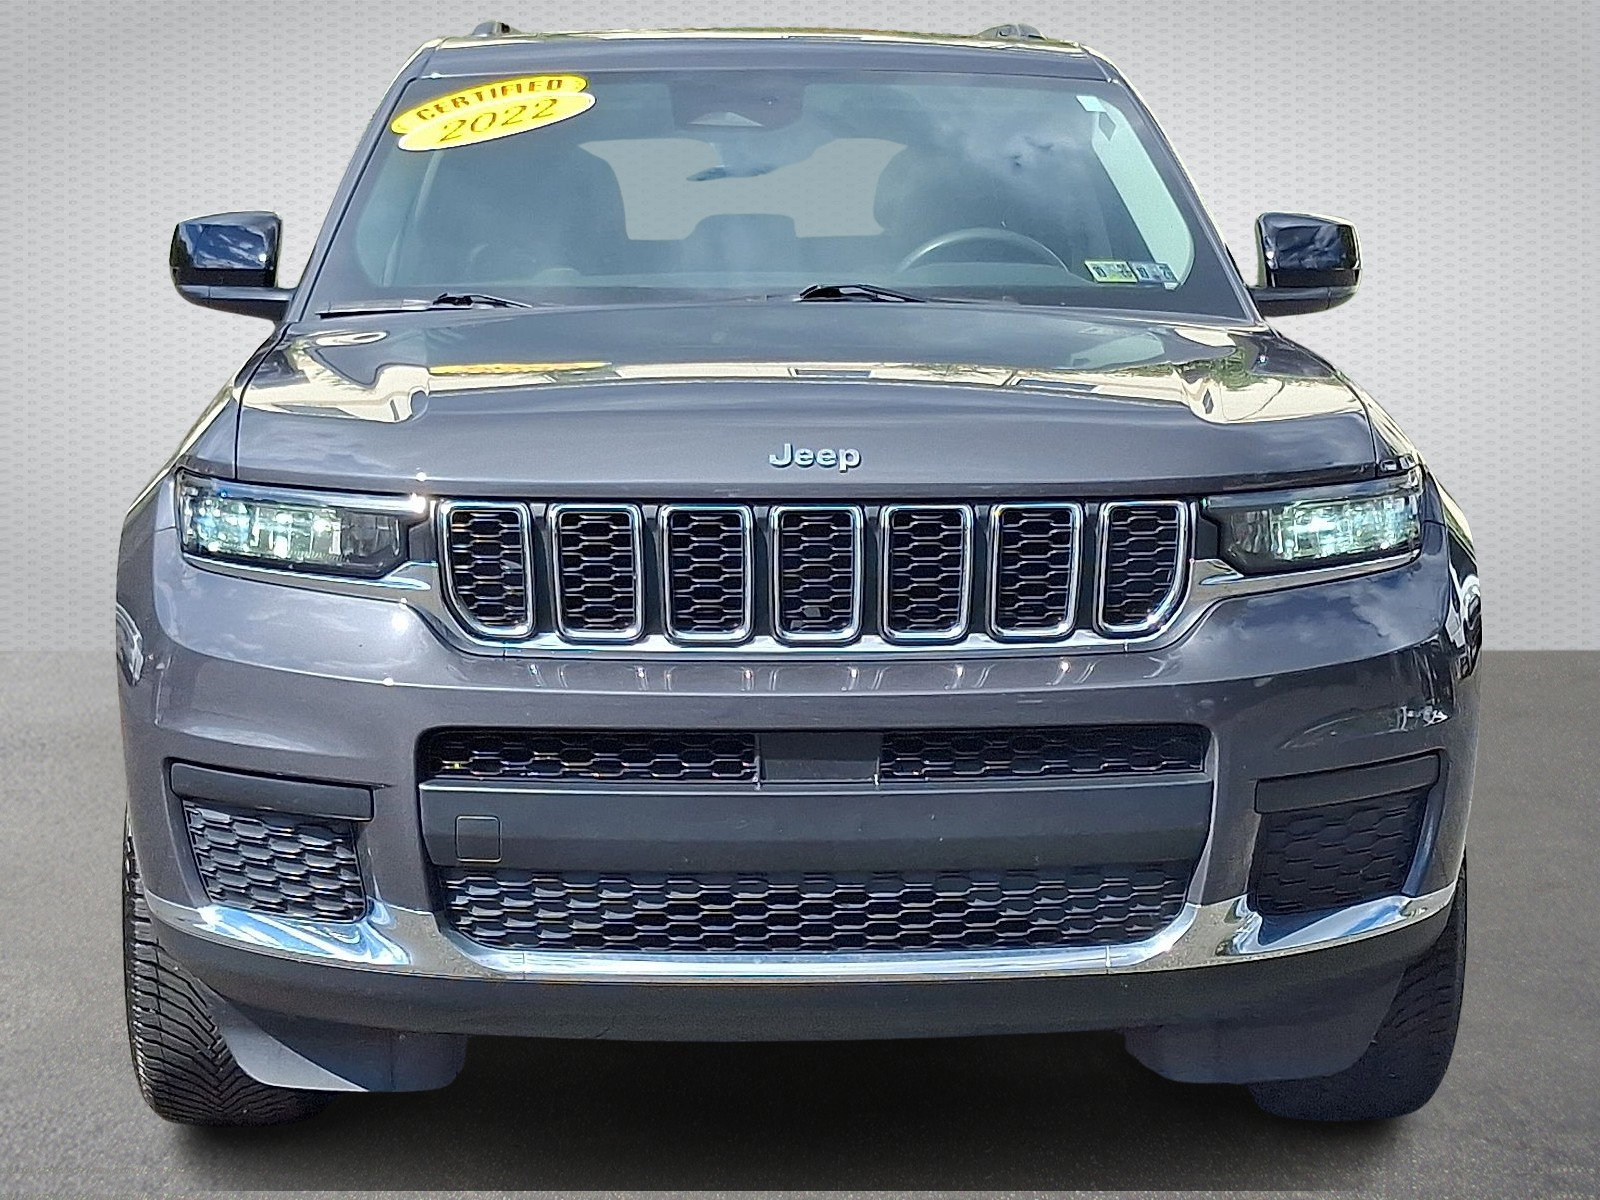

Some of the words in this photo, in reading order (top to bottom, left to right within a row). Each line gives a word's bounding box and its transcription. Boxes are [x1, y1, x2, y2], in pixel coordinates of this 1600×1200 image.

[416, 79, 563, 121] CERTIFIED
[439, 98, 558, 142] 2022
[769, 443, 861, 473] Jeep
